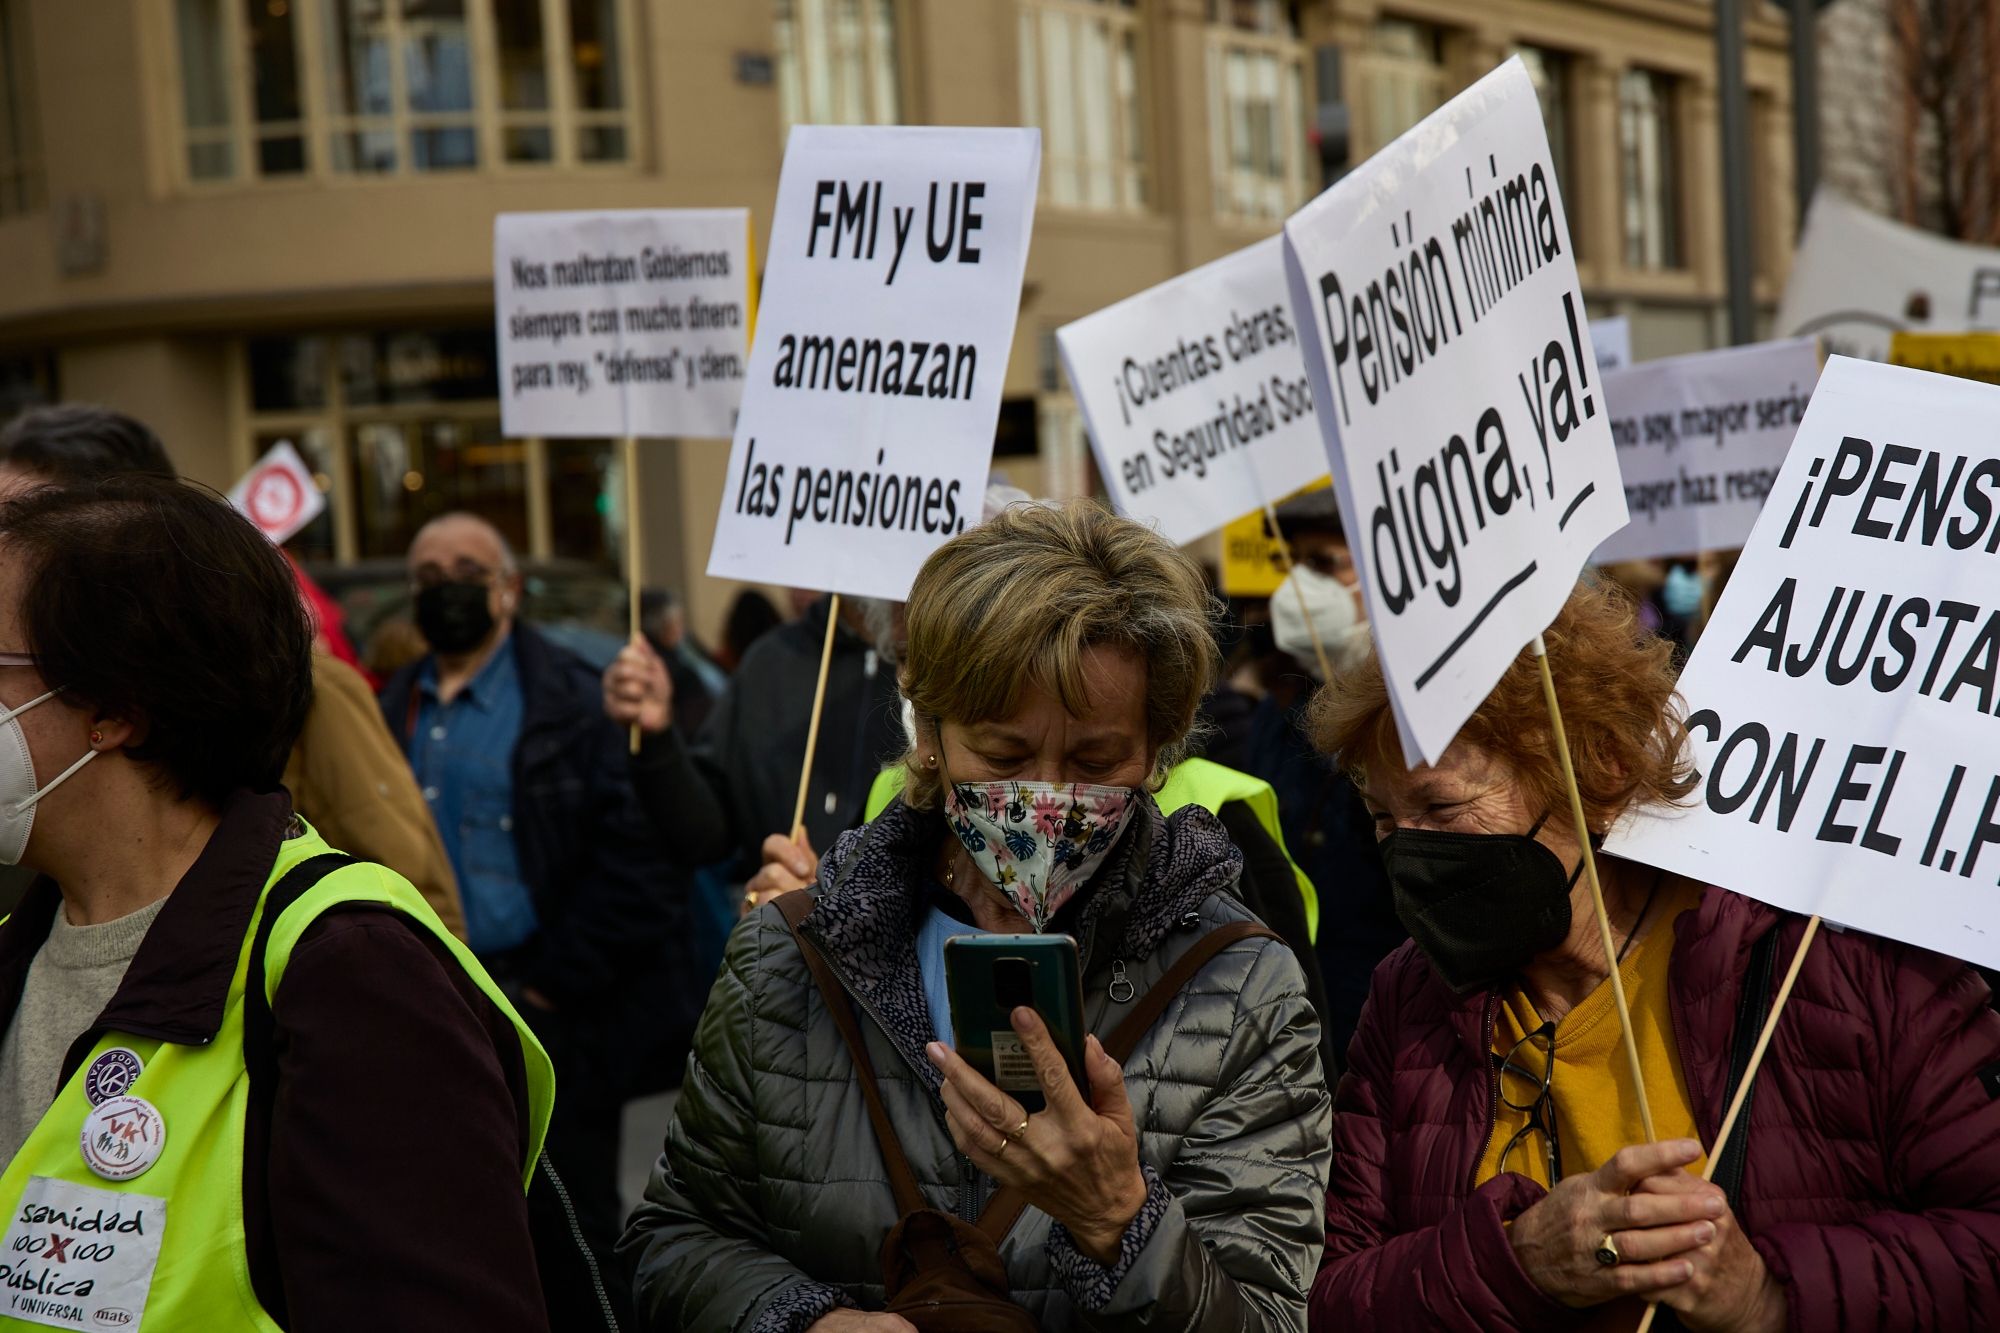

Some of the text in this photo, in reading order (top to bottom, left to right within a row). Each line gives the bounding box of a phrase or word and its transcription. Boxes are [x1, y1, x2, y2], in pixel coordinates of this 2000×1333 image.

[806, 180, 986, 286] FMI y UE
[511, 247, 730, 289] Nos maltratan Gobiernos
[1319, 154, 1561, 426] Pensión mínima
[509, 295, 741, 346] siempre con mucho dinero
[513, 363, 552, 396] para
[684, 356, 696, 389] y
[773, 333, 977, 401] amenazan
[1114, 336, 1222, 427] ¡Cuentas
[1122, 374, 1313, 495] en Seguridad Soc
[1372, 291, 1596, 616] digna, ya!
[1680, 402, 1748, 447] mayor
[736, 437, 965, 546] las pensiones.
[1680, 464, 1719, 506] haz
[1732, 578, 2000, 718] AJUSTA
[1816, 744, 1906, 857] EL
[1919, 764, 2000, 887] I.P
[89, 1063, 104, 1103] VALLEK
[111, 1054, 137, 1091] PODEM
[11, 1295, 83, 1321] Y UNIVERSAL
[95, 1309, 131, 1323] mats
